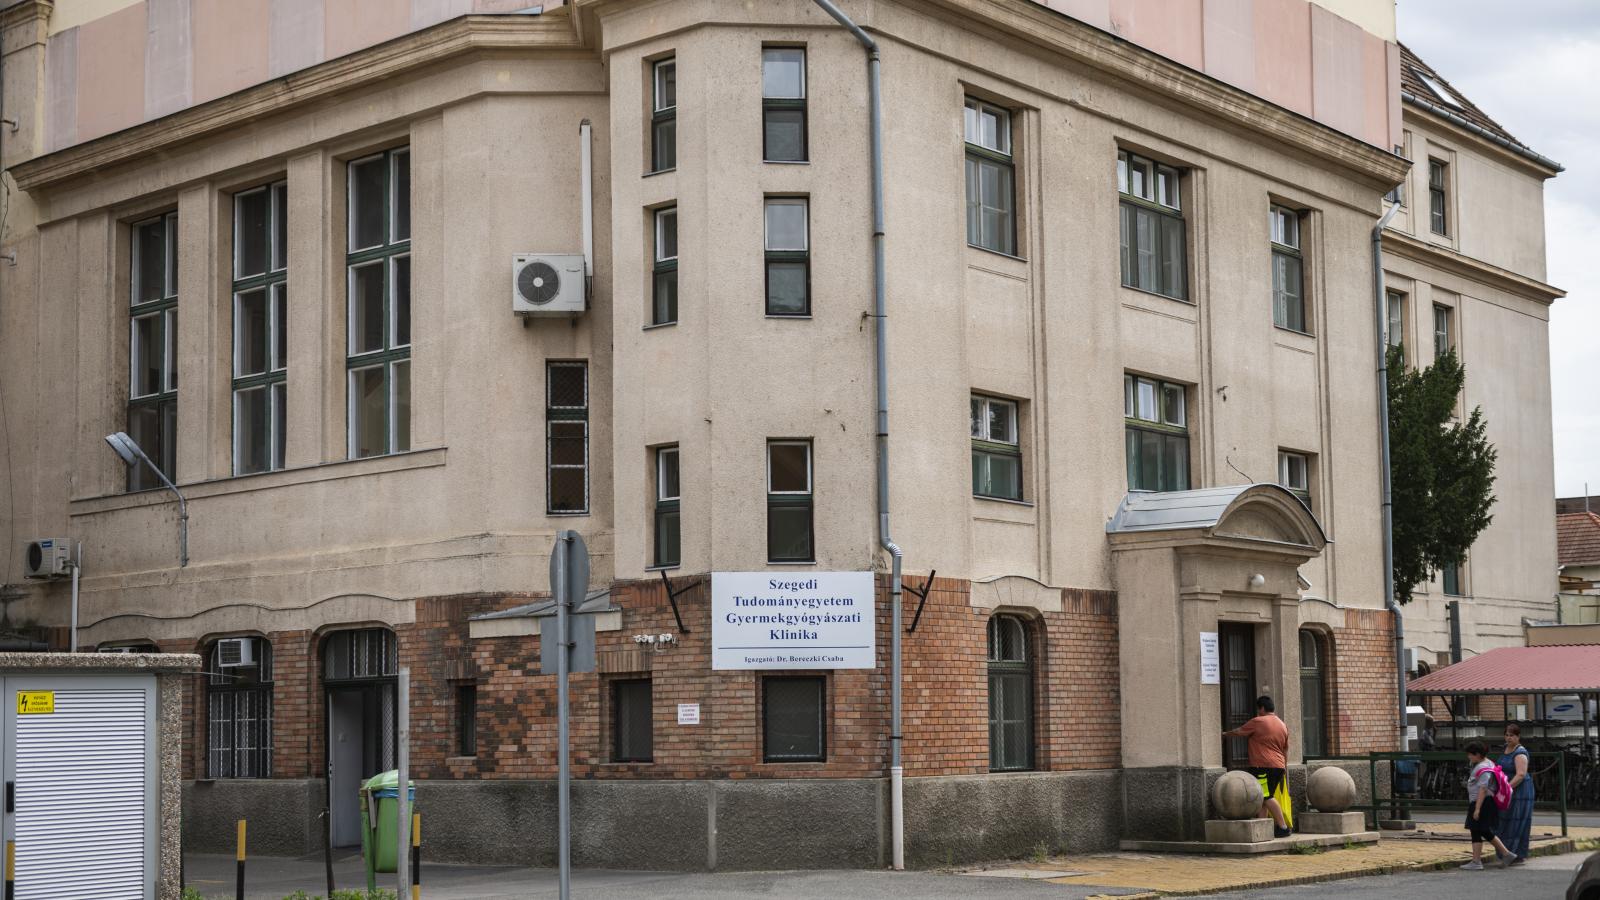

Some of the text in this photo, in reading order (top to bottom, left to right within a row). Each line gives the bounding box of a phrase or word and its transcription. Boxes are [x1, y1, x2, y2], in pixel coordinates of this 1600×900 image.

[769, 578, 818, 592] Szegedi
[733, 596, 853, 609] Tudományegyetem
[726, 612, 861, 626] Gyermekgyógyászati
[770, 629, 818, 640] Klinika
